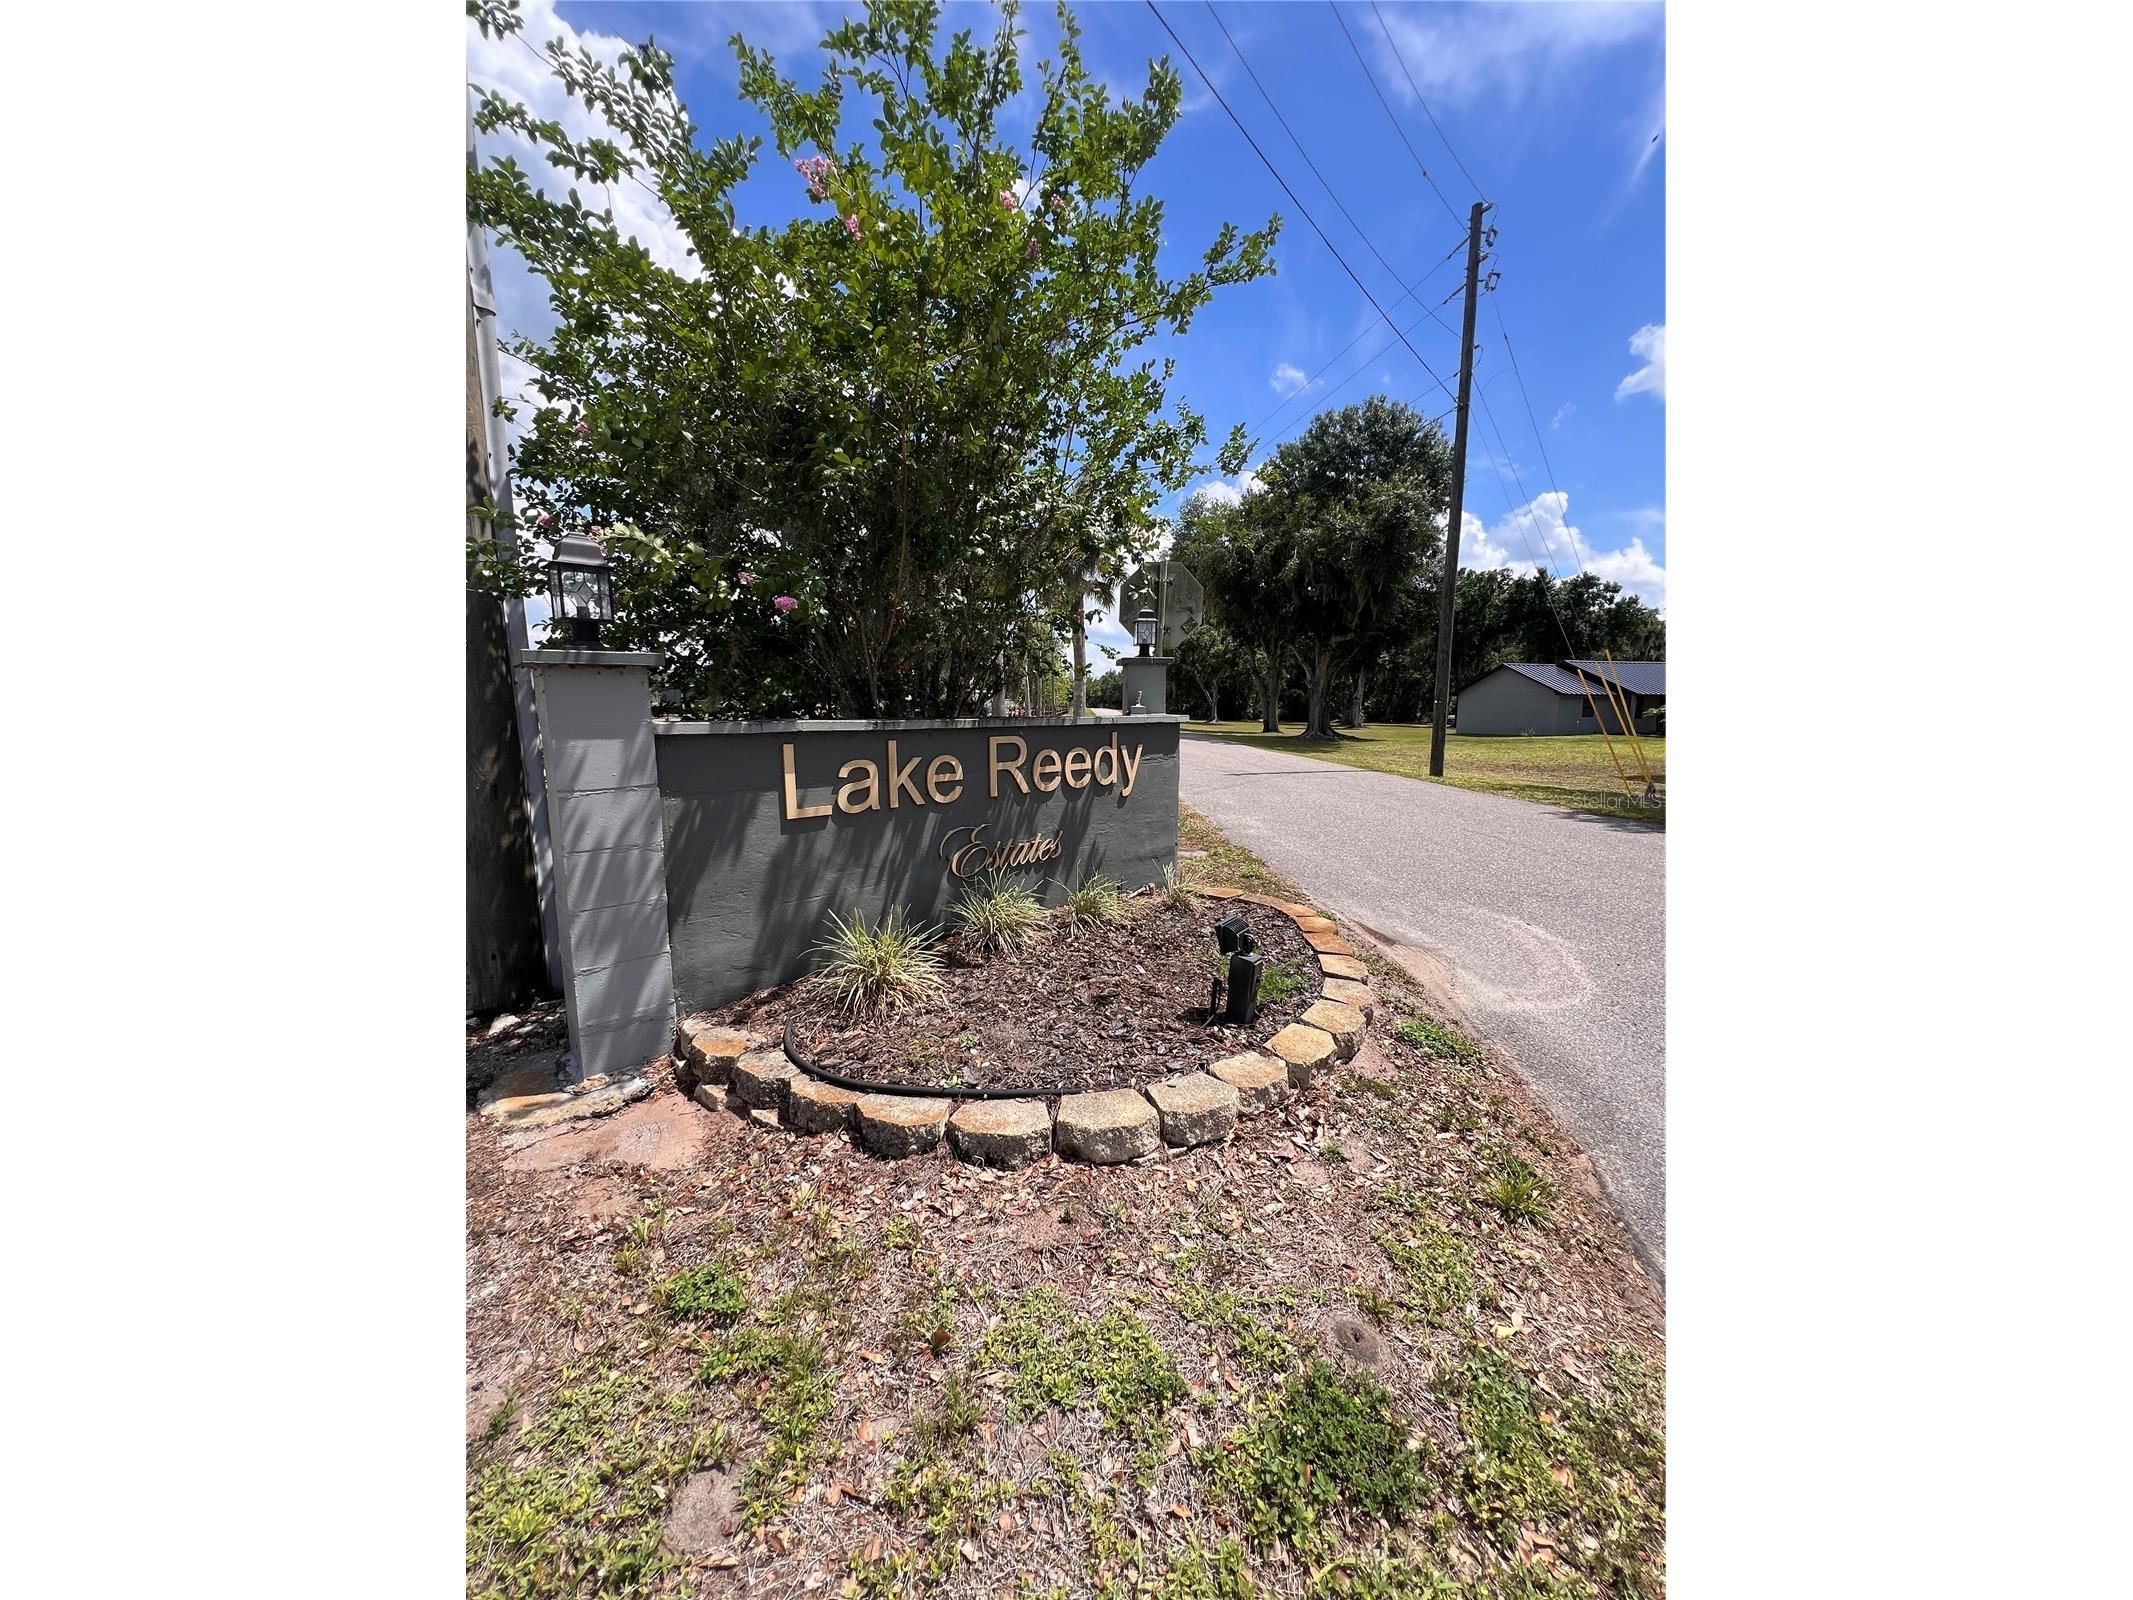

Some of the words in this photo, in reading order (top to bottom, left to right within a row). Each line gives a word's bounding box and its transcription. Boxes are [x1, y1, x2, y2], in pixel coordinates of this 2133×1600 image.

[781, 739, 965, 820] Lake
[988, 732, 1143, 797] Reedy
[939, 823, 1063, 881] Estates
